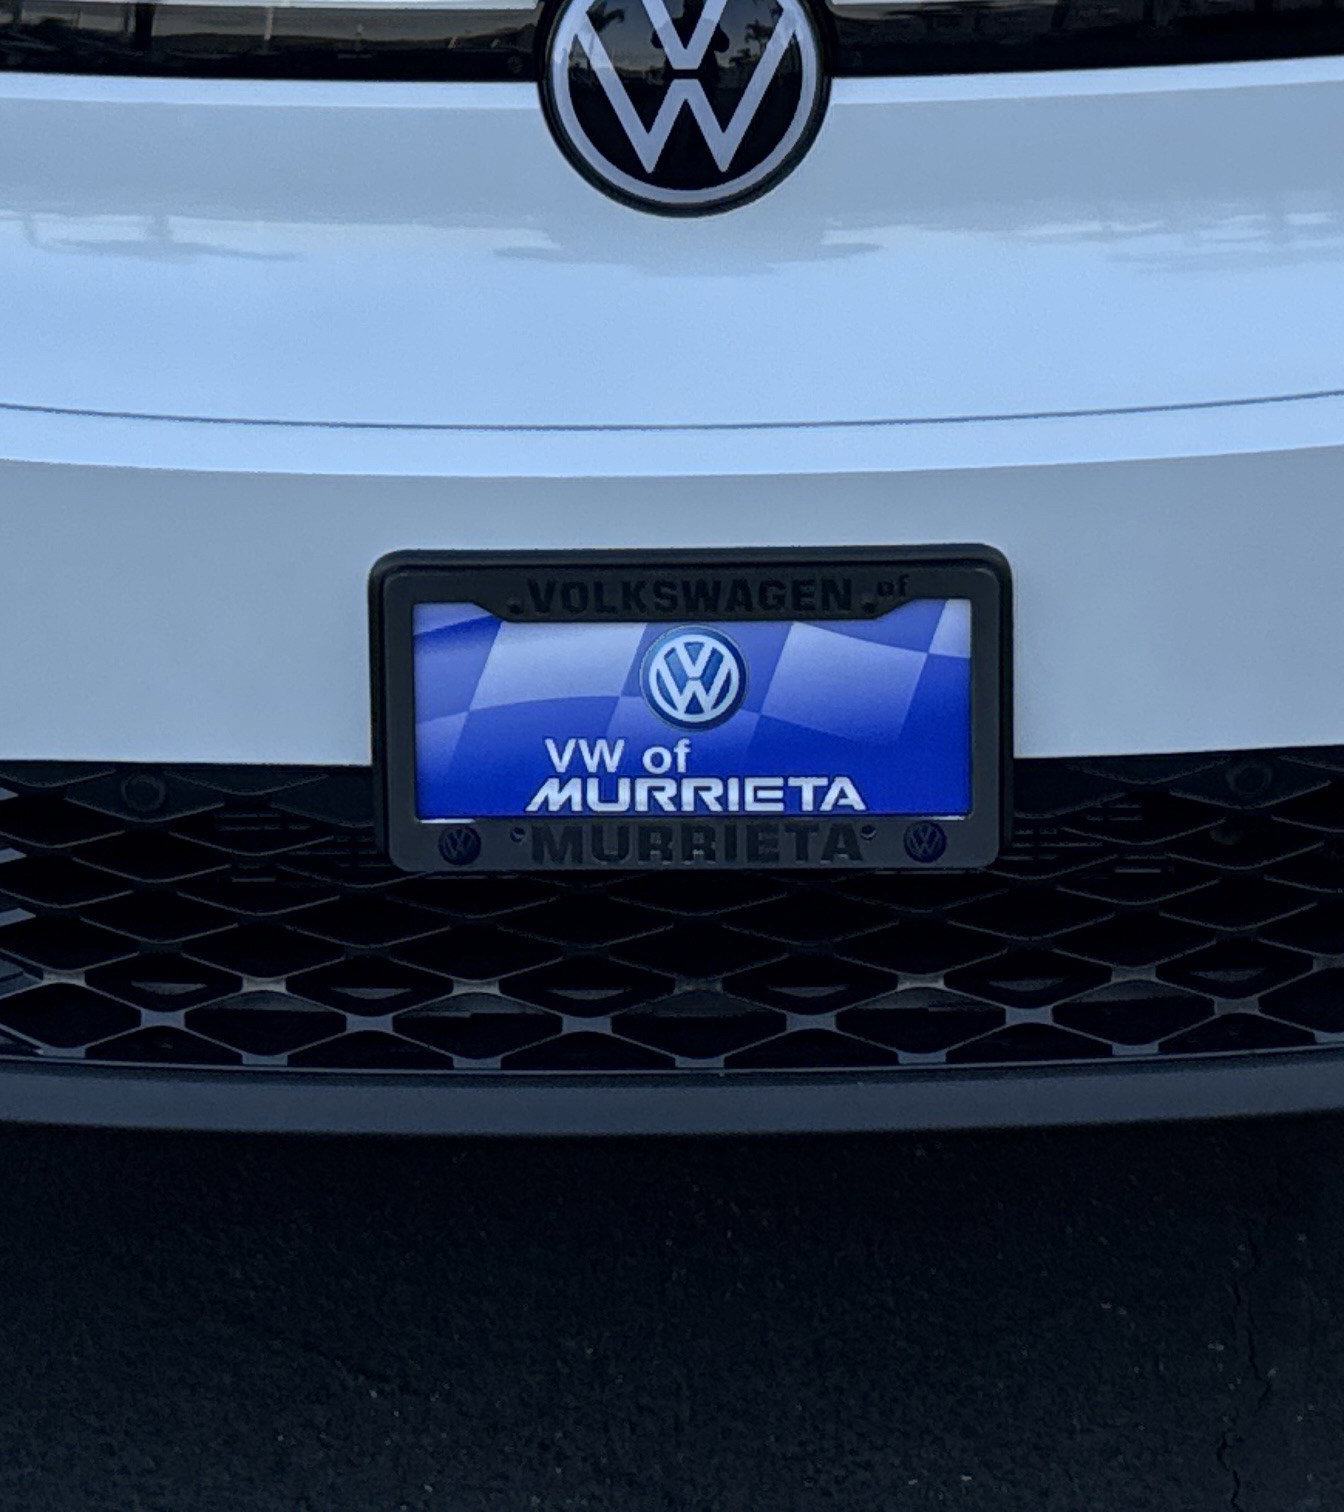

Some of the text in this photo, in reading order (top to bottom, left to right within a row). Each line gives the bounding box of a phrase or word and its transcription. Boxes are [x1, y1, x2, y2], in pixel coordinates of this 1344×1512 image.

[527, 574, 910, 614] VOLKSWAGEN of
[649, 633, 741, 723] VW
[544, 737, 692, 775] VW of
[523, 775, 868, 813] MURRIETA
[531, 823, 866, 864] MURRIETA
